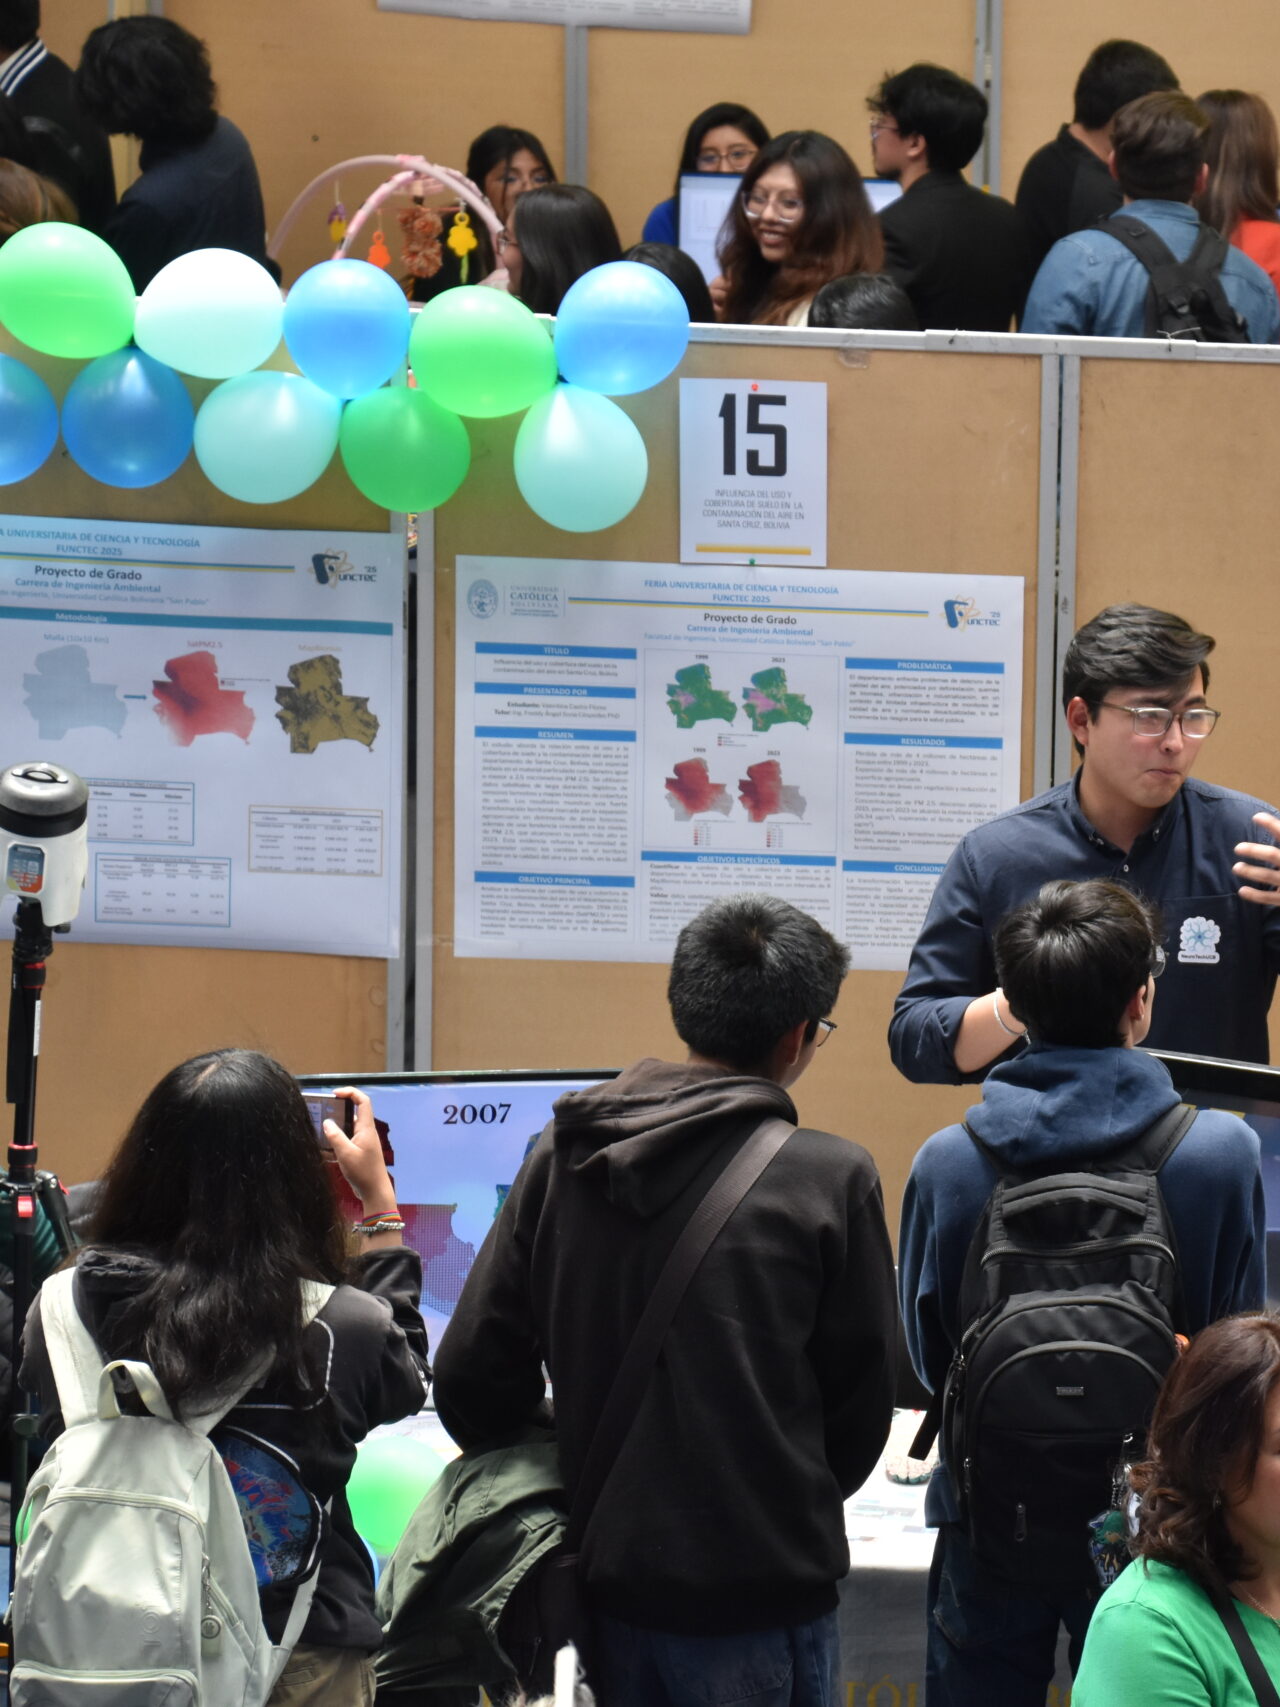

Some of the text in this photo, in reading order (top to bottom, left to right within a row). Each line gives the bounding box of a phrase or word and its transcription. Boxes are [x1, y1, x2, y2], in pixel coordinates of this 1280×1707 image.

[718, 393, 787, 477] 15
[715, 489, 755, 498] INFLUENCIA
[757, 489, 768, 498] DEL
[704, 499, 746, 508] COBERTURA
[7, 528, 200, 547] UNIVERSITARIA DE CIENCIA Y TECNOLOGÍA
[56, 544, 122, 556] FUNCTEC 2025
[35, 565, 142, 581] Proyecto de Grado
[15, 578, 49, 587] Carrera
[51, 580, 63, 588] de
[114, 583, 161, 593] Ambiental
[644, 580, 839, 596] FERIA UNIVERSITARIA DE CIENCIA Y TECNOLOGÍA
[510, 591, 559, 601] CATÓLICA
[712, 593, 771, 603] FUNCTEC 2025
[704, 612, 797, 625] Proyecto de Grado
[687, 624, 717, 633] Carrera
[718, 625, 728, 633] de
[772, 627, 814, 637] Ambiental
[897, 660, 952, 671] PROBLEMÁTICA
[572, 688, 588, 696] POR
[697, 855, 735, 864] OBJETIVOS
[894, 864, 946, 873] CONCLUSIONE
[518, 875, 591, 886] OBJETIVO PRINCIPAL
[442, 1103, 512, 1125] 2007
